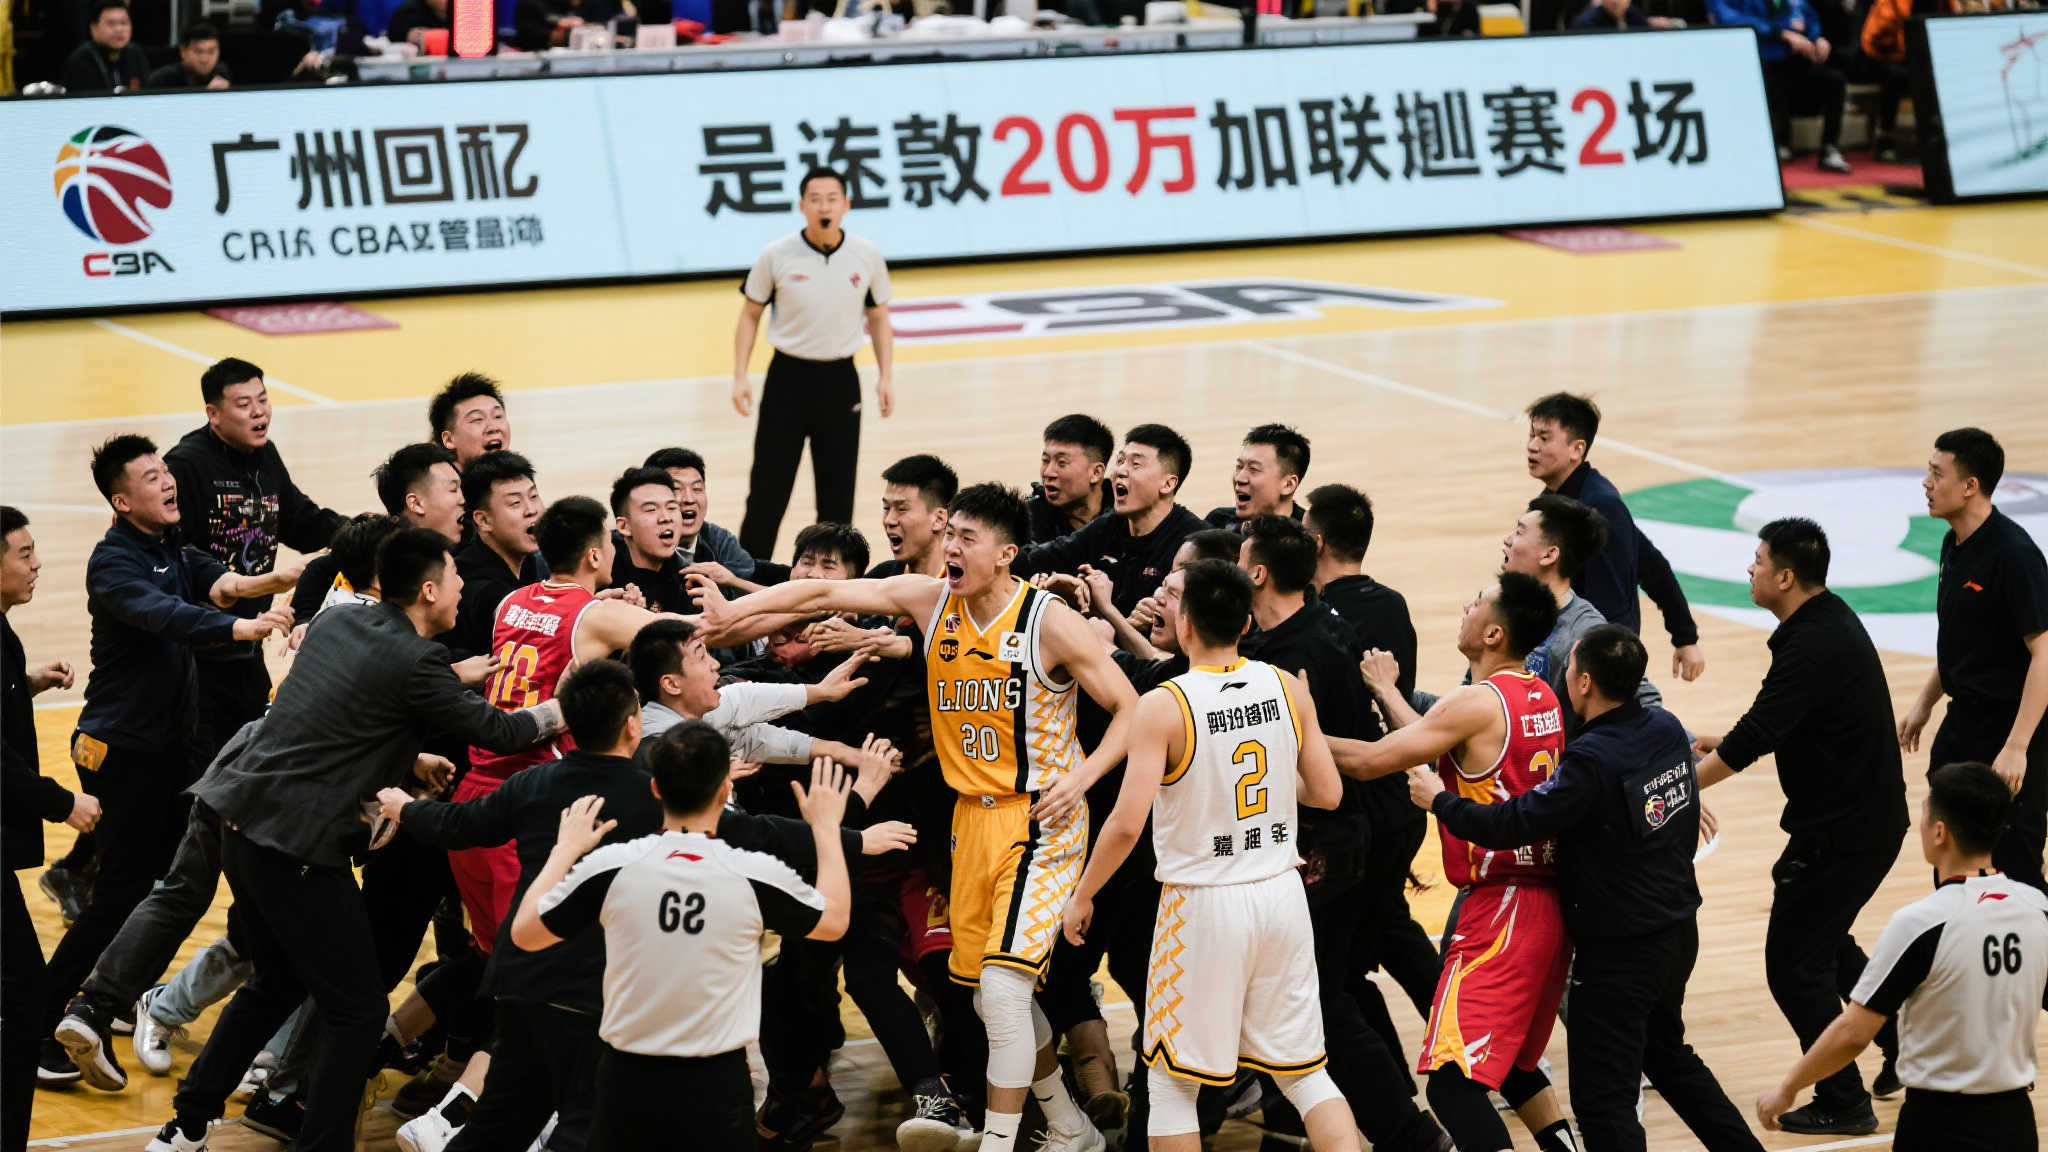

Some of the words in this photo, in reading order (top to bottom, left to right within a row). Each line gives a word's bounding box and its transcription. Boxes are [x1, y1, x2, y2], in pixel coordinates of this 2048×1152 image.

[937, 678, 1022, 712] LIONS
[960, 723, 1000, 762] 20
[1232, 739, 1268, 821] 2
[659, 890, 706, 935] 62
[1983, 932, 2022, 977] 66
